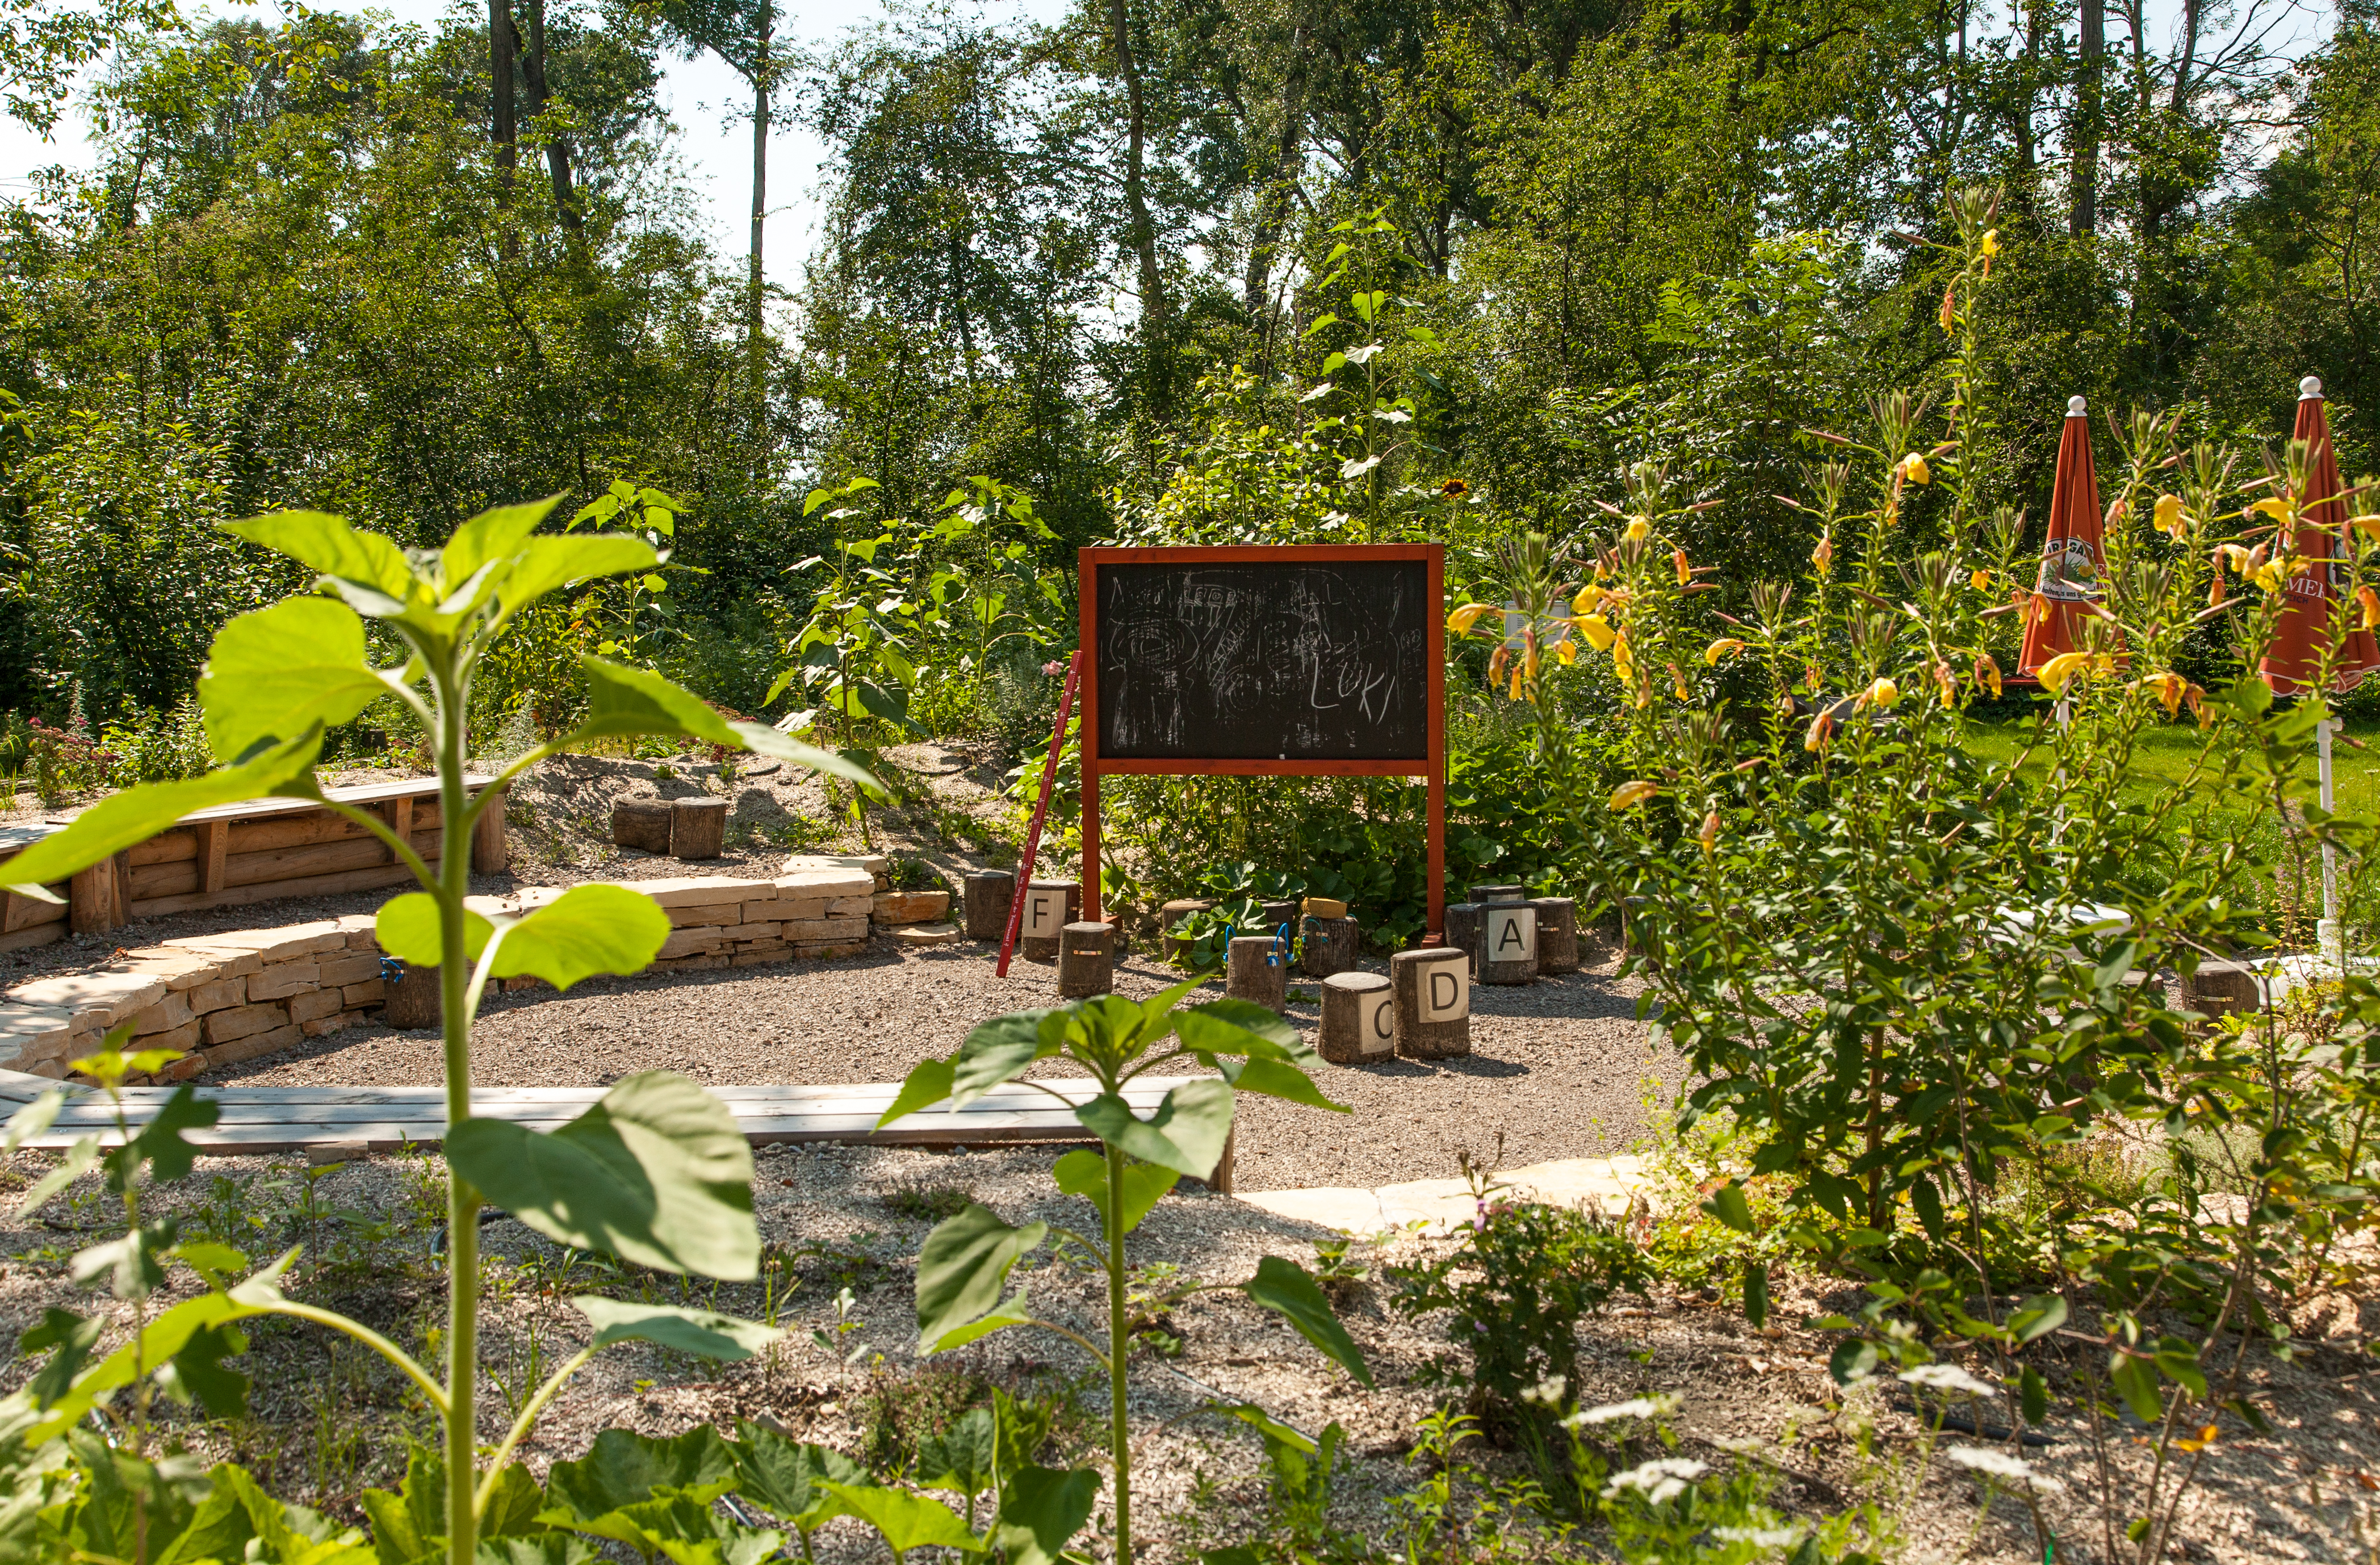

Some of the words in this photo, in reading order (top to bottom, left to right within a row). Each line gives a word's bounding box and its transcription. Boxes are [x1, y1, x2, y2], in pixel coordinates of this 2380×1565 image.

[1310, 653, 1396, 725] LUKI
[1033, 899, 1049, 928] F
[1498, 918, 1526, 952] A
[1430, 972, 1459, 1011] D
